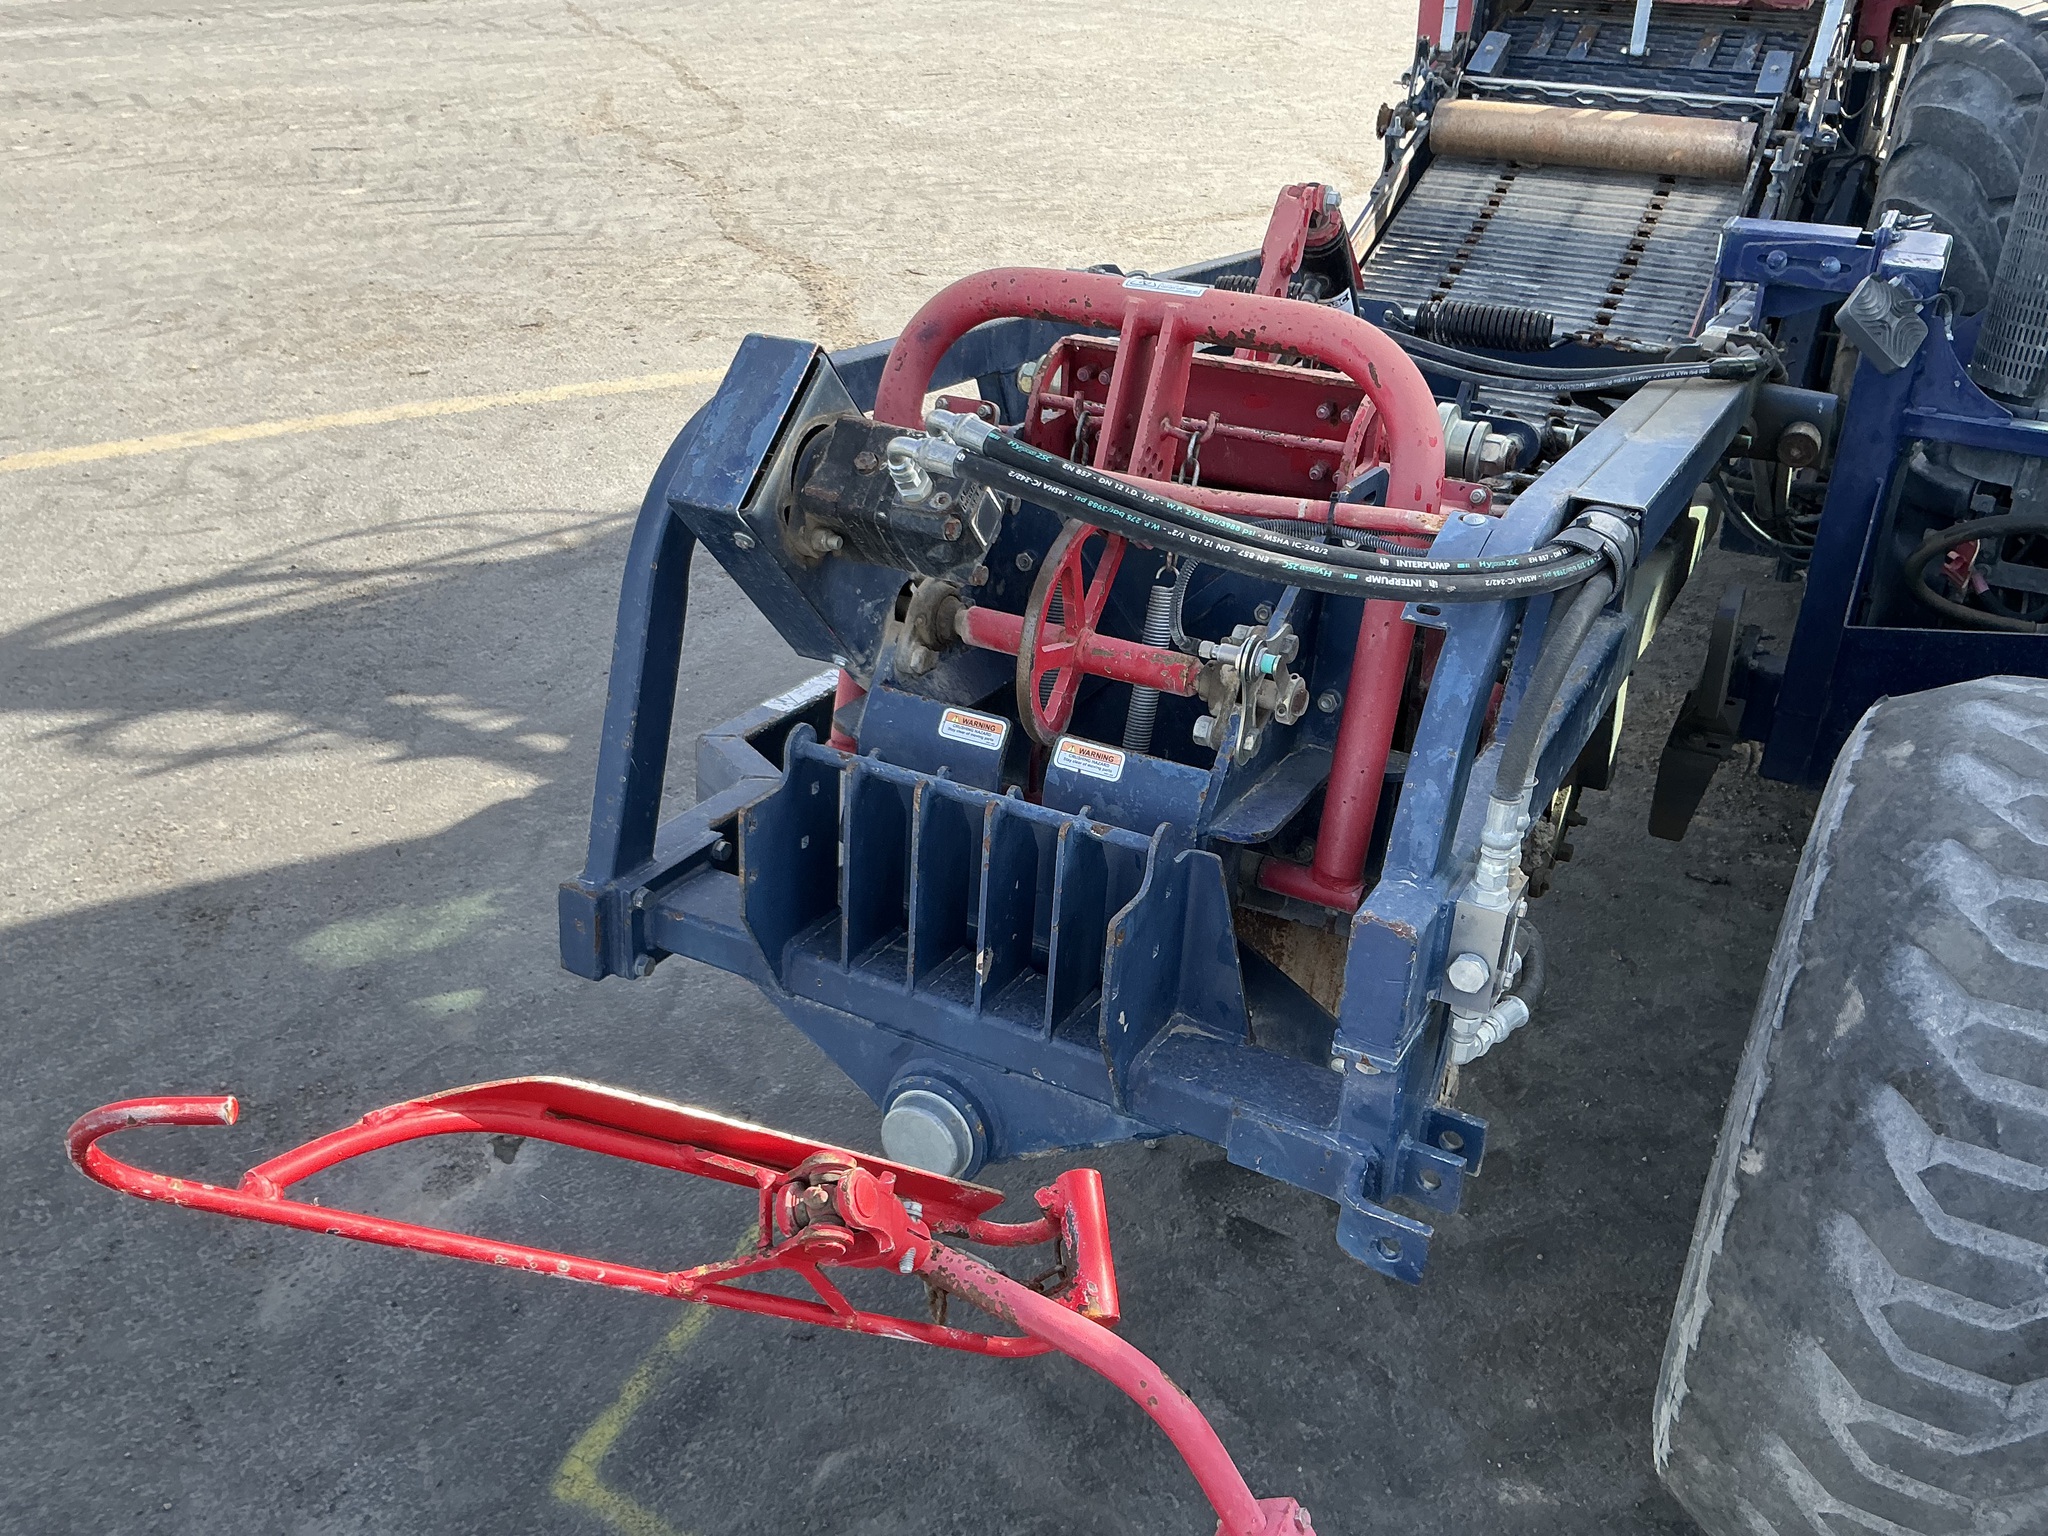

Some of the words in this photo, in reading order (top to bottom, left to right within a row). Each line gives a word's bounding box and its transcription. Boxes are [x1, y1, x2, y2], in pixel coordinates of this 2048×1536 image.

[1008, 470, 1042, 488] IC-242/2
[1043, 482, 1067, 497] MSHA
[1073, 495, 1088, 504] psi
[1062, 463, 1074, 473] EN
[1075, 468, 1092, 479] 857
[1098, 477, 1112, 488] DN
[1114, 481, 1124, 491] 12
[1125, 486, 1139, 498] I.D.
[1166, 501, 1183, 513] W.P.
[1185, 507, 1201, 519] 275
[1202, 514, 1241, 532] bar/3988
[1241, 525, 1256, 538] psi
[1263, 533, 1290, 547] MSHA
[1292, 540, 1329, 555] IC-242/2
[1087, 499, 1126, 520] bar/3988
[1126, 514, 1142, 525] 275
[1143, 520, 1161, 532] W.P.
[1189, 535, 1204, 545] I.D.
[1204, 539, 1213, 548] 12
[1216, 543, 1231, 553] DN
[1237, 550, 1256, 562] 857
[1257, 555, 1270, 564] EN
[1396, 559, 1450, 570] INTERPUMP
[1528, 556, 1538, 564] EN
[1538, 554, 1549, 562] 857
[1365, 574, 1422, 588] INTERPUMP
[1485, 577, 1515, 587] IC-242/2
[1517, 574, 1537, 583] MSHA
[962, 717, 996, 732] WARNING
[1079, 747, 1115, 763] WARNING
[1091, 760, 1110, 768] HAZARD
